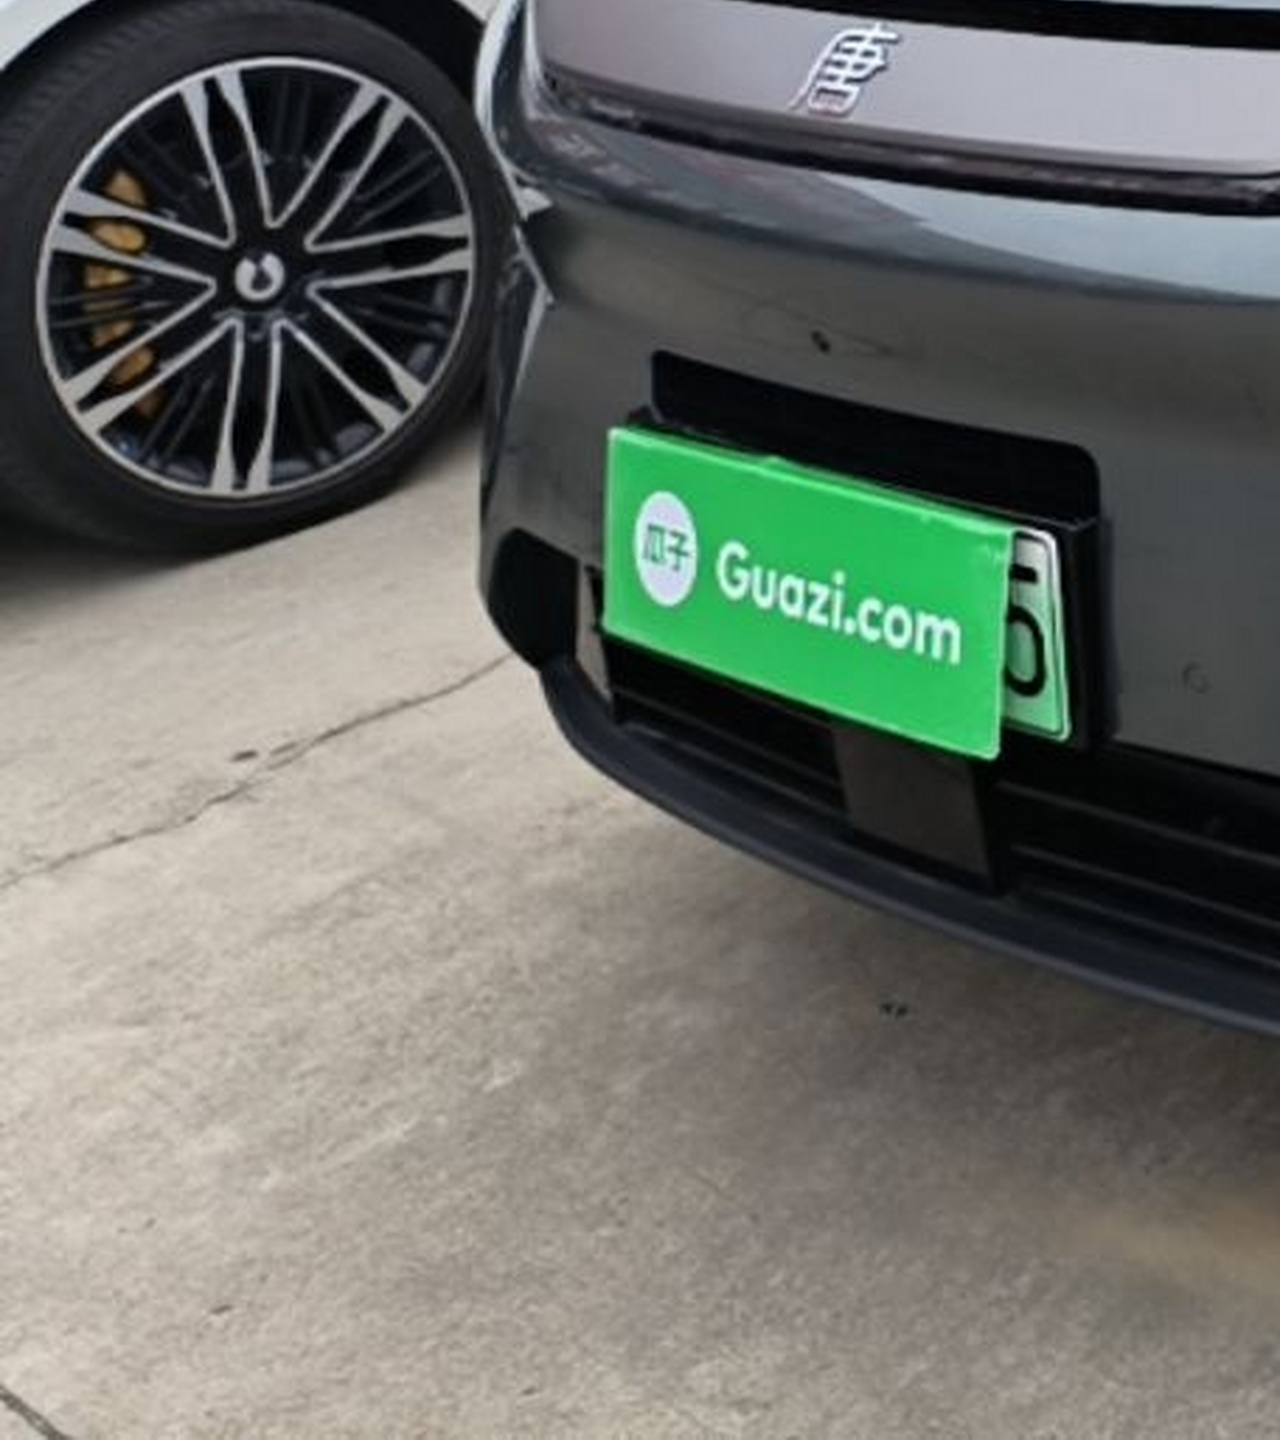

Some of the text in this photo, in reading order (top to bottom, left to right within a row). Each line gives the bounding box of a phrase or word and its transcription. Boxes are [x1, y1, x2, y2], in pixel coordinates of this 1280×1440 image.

[788, 21, 901, 117] 唐
[643, 522, 690, 572] 瓜子
[716, 540, 962, 665] Guazi.com
